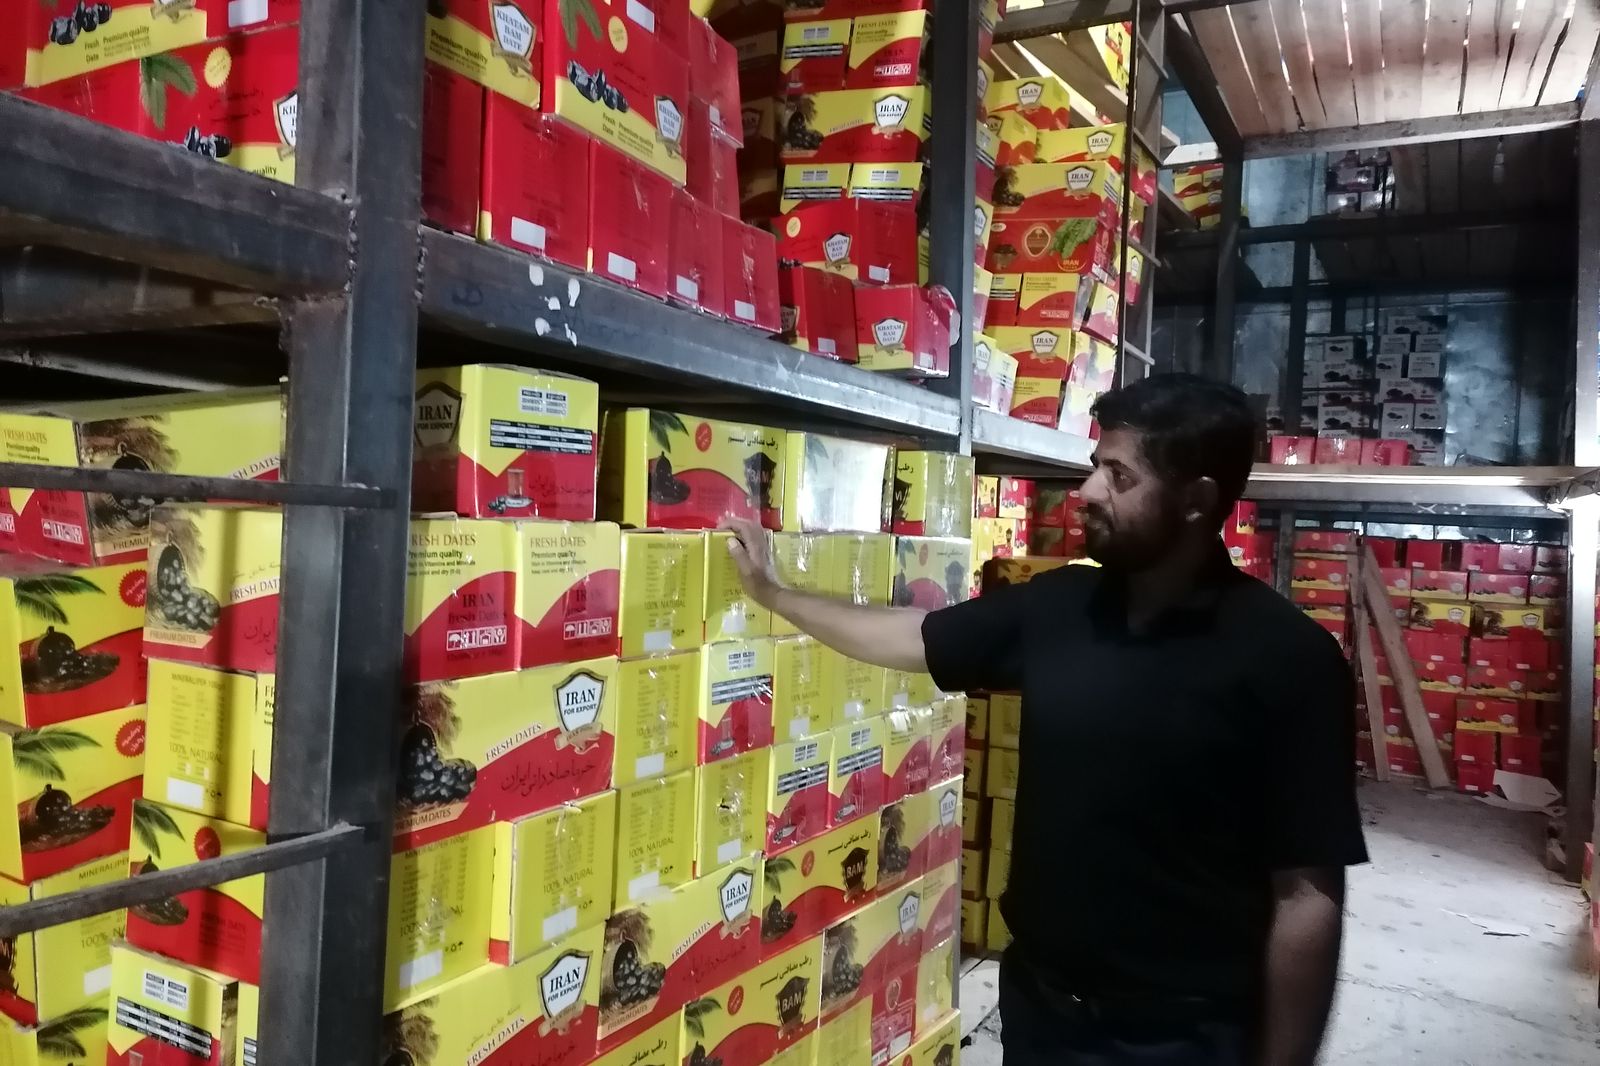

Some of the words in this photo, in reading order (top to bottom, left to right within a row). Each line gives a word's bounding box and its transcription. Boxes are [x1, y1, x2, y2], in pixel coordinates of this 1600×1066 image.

[496, 9, 530, 35] KHATAM
[129, 25, 150, 38] quality
[505, 25, 521, 41] BAM
[430, 29, 463, 52] Premium
[464, 47, 488, 63] quality
[880, 103, 903, 113] IRAN
[419, 405, 452, 420] IRAN
[417, 422, 429, 430] FOR
[431, 422, 453, 430] EXPORT
[897, 463, 914, 473] رطب
[113, 535, 150, 550] PREMIU
[411, 533, 438, 546] RESH
[443, 533, 477, 546] DATES
[530, 537, 557, 548] FRESH
[560, 536, 586, 547] DATES
[439, 549, 463, 560] quality
[531, 551, 556, 559] Premium
[230, 585, 257, 600] FRESH
[463, 592, 495, 608] IRAN
[565, 688, 596, 706] IRAN
[563, 708, 575, 716] FOR
[576, 703, 597, 713] EXPORT
[486, 737, 513, 761] FRESH
[515, 722, 542, 743] DATES
[190, 747, 225, 765] NATURAL
[429, 808, 451, 821] DATES
[846, 860, 864, 879] BAM
[726, 881, 748, 902] IRAN
[902, 902, 916, 918] IRAN
[81, 929, 108, 948] 100%
[671, 938, 692, 960] FRESH
[692, 921, 711, 940] DATES
[799, 955, 812, 967] رطب
[549, 967, 581, 993] IRAN
[548, 993, 559, 1003] FOR
[560, 982, 582, 997] EXPORT
[782, 991, 802, 1012] BAM
[466, 1040, 496, 1066] FRESH
[498, 1016, 525, 1041] DATES
[651, 1038, 667, 1054] رطب
